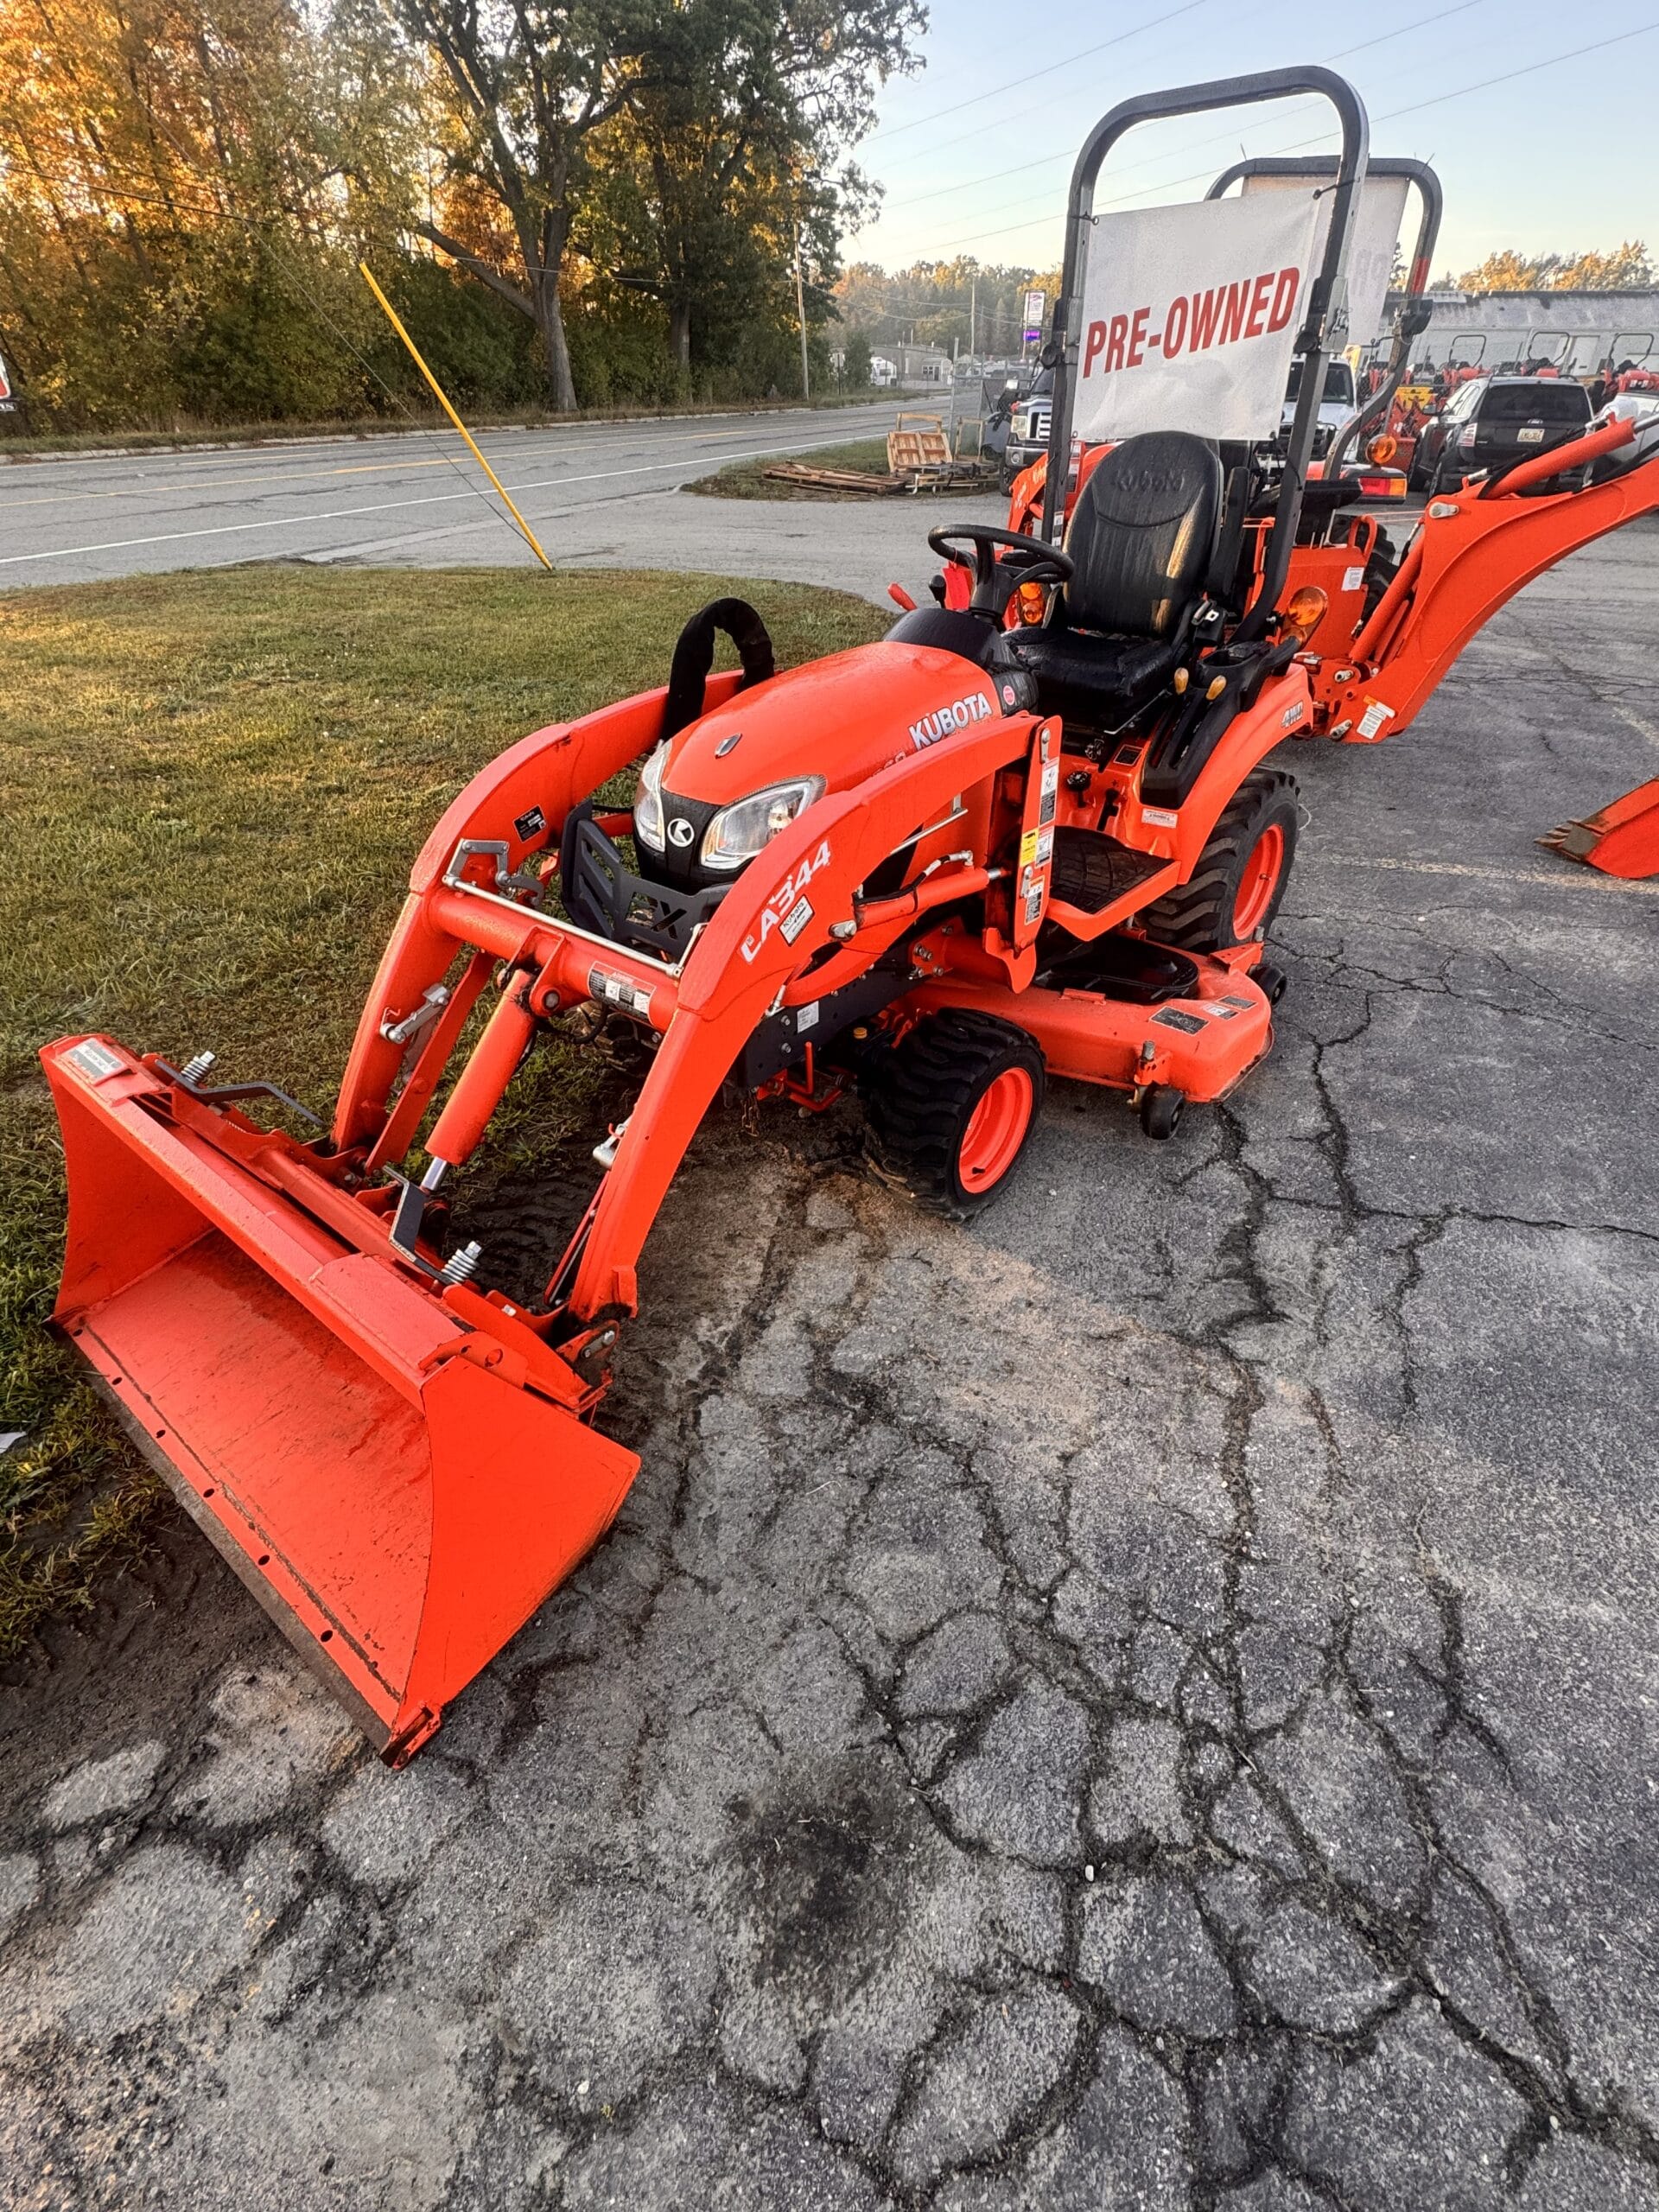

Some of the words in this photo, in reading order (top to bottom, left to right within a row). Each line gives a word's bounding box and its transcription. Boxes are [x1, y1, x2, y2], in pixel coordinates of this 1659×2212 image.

[1084, 267, 1300, 378] PRE-OWNED
[909, 692, 993, 750] KUBOTA
[741, 840, 831, 963] LA344
